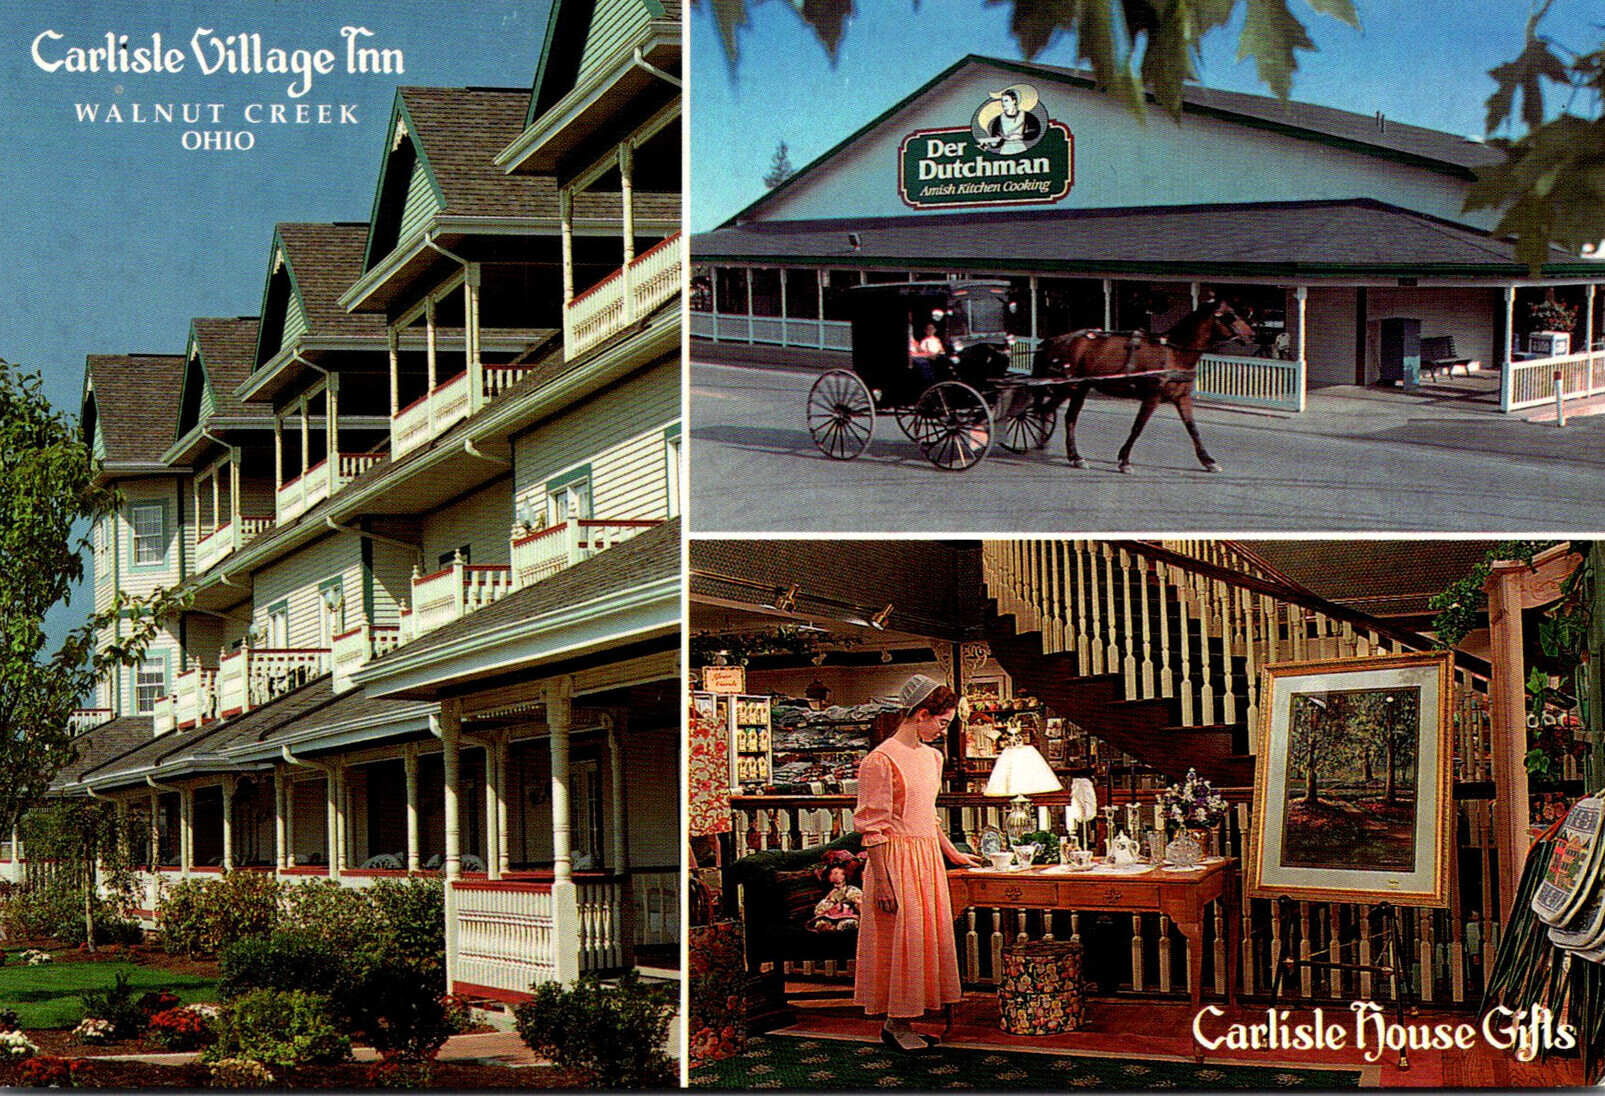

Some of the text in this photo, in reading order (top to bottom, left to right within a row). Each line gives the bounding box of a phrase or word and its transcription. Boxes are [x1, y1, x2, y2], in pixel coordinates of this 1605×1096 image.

[927, 139, 967, 158] Der
[918, 156, 1050, 180] Dutchman
[920, 180, 1051, 196] Amish Kitchen Cooking
